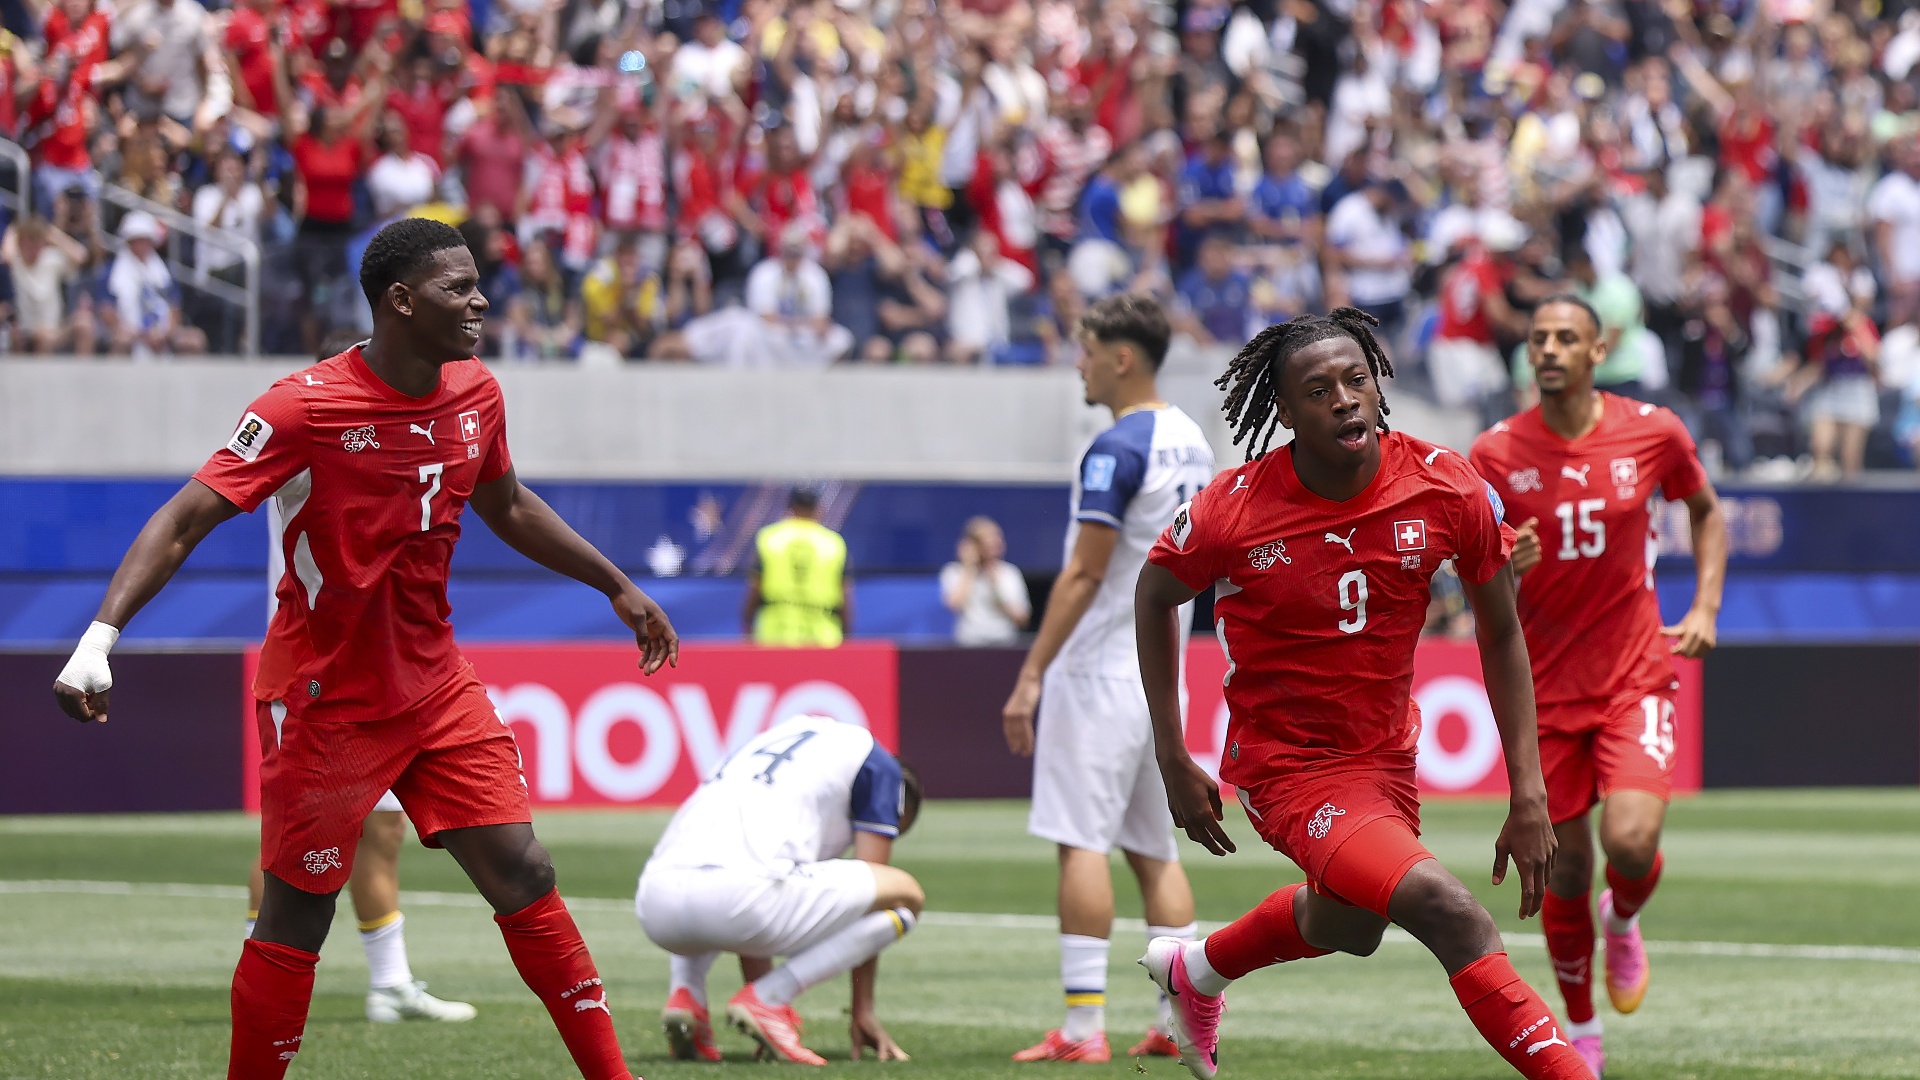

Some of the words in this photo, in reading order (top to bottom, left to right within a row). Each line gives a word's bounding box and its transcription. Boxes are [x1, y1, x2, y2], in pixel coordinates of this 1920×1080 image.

[418, 462, 444, 532] 7
[1555, 498, 1606, 560] 15
[1337, 568, 1369, 634] 9
[1509, 1015, 1550, 1049] suisse
